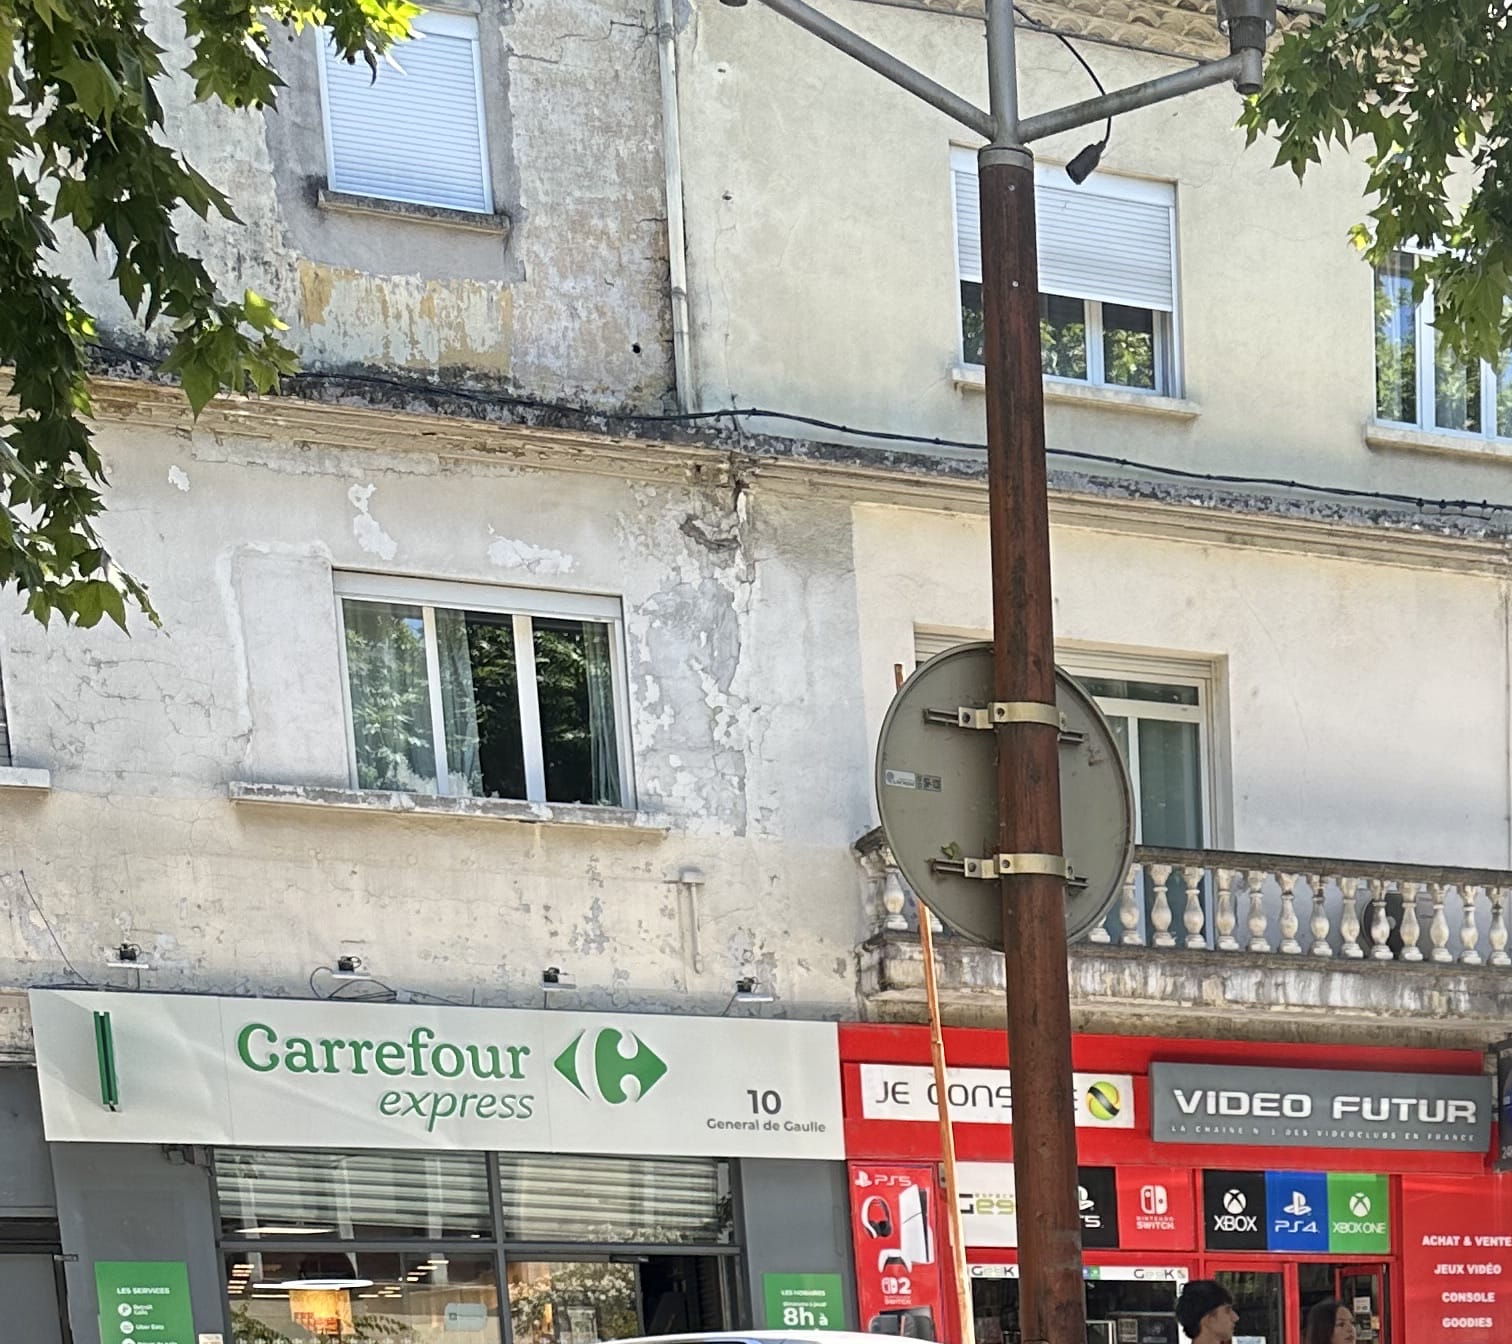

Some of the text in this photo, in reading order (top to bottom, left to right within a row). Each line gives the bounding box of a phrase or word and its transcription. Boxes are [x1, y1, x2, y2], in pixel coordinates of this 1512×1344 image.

[237, 1023, 531, 1079] Carrefour
[876, 1081, 910, 1105] JE
[747, 1089, 781, 1115] 10
[1173, 1089, 1477, 1124] VIDEO FUTUR
[379, 1090, 535, 1133] express
[706, 1118, 826, 1132] General de Gaulle
[1171, 1125, 1187, 1133] LA
[1195, 1126, 1244, 1135] CHAINE
[1285, 1129, 1309, 1137] DES
[1316, 1130, 1397, 1140] VIDEOCLUBS
[1404, 1132, 1420, 1141] EN
[1427, 1134, 1475, 1143] FRANCE
[874, 1173, 912, 1187] PS5
[1136, 1220, 1175, 1231] SWITCH
[1214, 1215, 1257, 1232] XBOX
[1274, 1220, 1318, 1233] PS4
[1422, 1235, 1512, 1247] ACHAT & VENTE
[1434, 1262, 1502, 1275] JEUX VIDÉO
[1441, 1292, 1496, 1303] CONSOLE
[783, 1307, 829, 1326] 8h à
[1442, 1317, 1493, 1328] GOODIES
